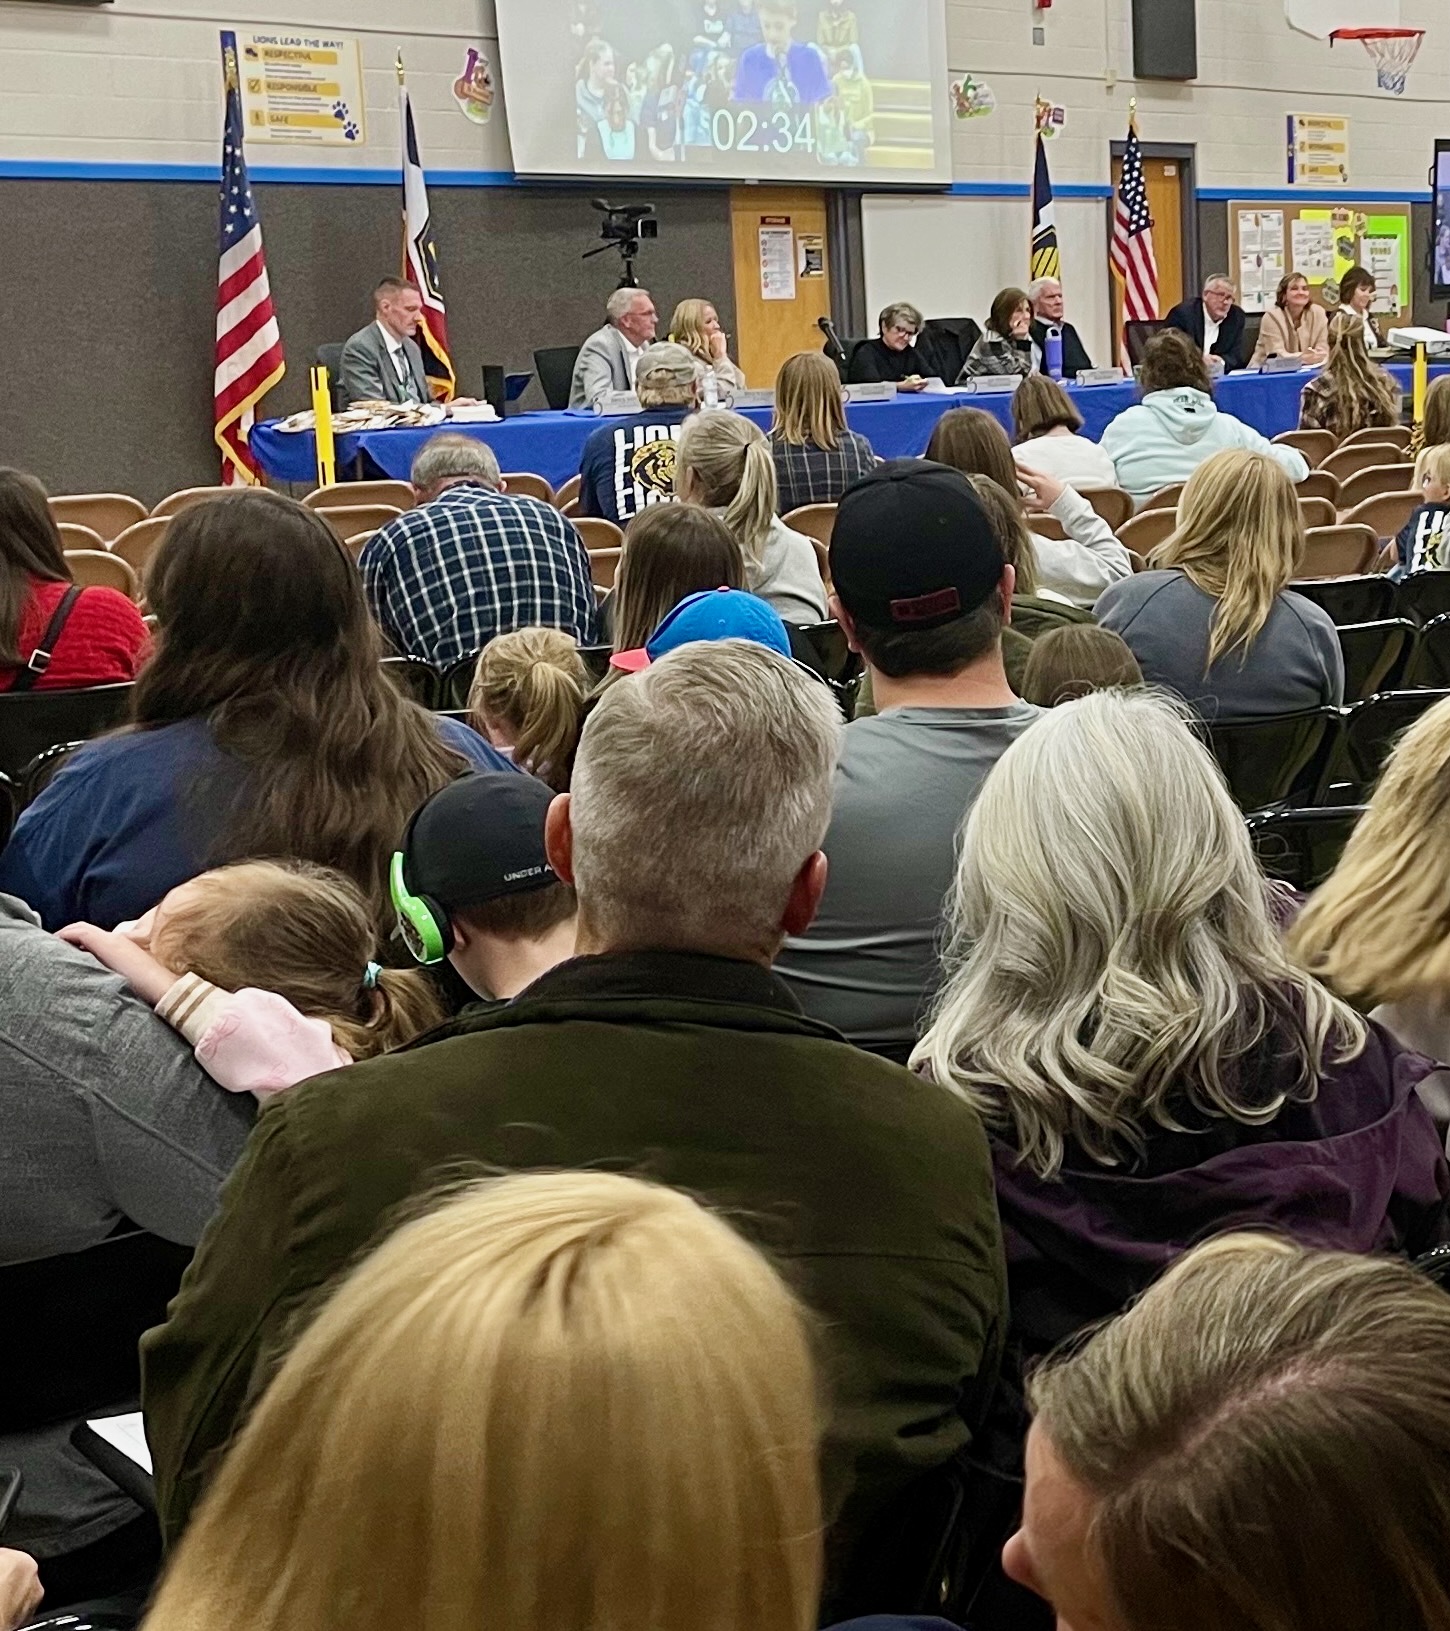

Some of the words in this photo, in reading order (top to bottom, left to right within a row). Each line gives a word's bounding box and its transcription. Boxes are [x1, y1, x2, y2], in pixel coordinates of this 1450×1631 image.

[280, 37, 302, 46] LEAD
[304, 39, 320, 48] THE
[712, 108, 816, 153] 02:34
[503, 866, 542, 881] UNDER
